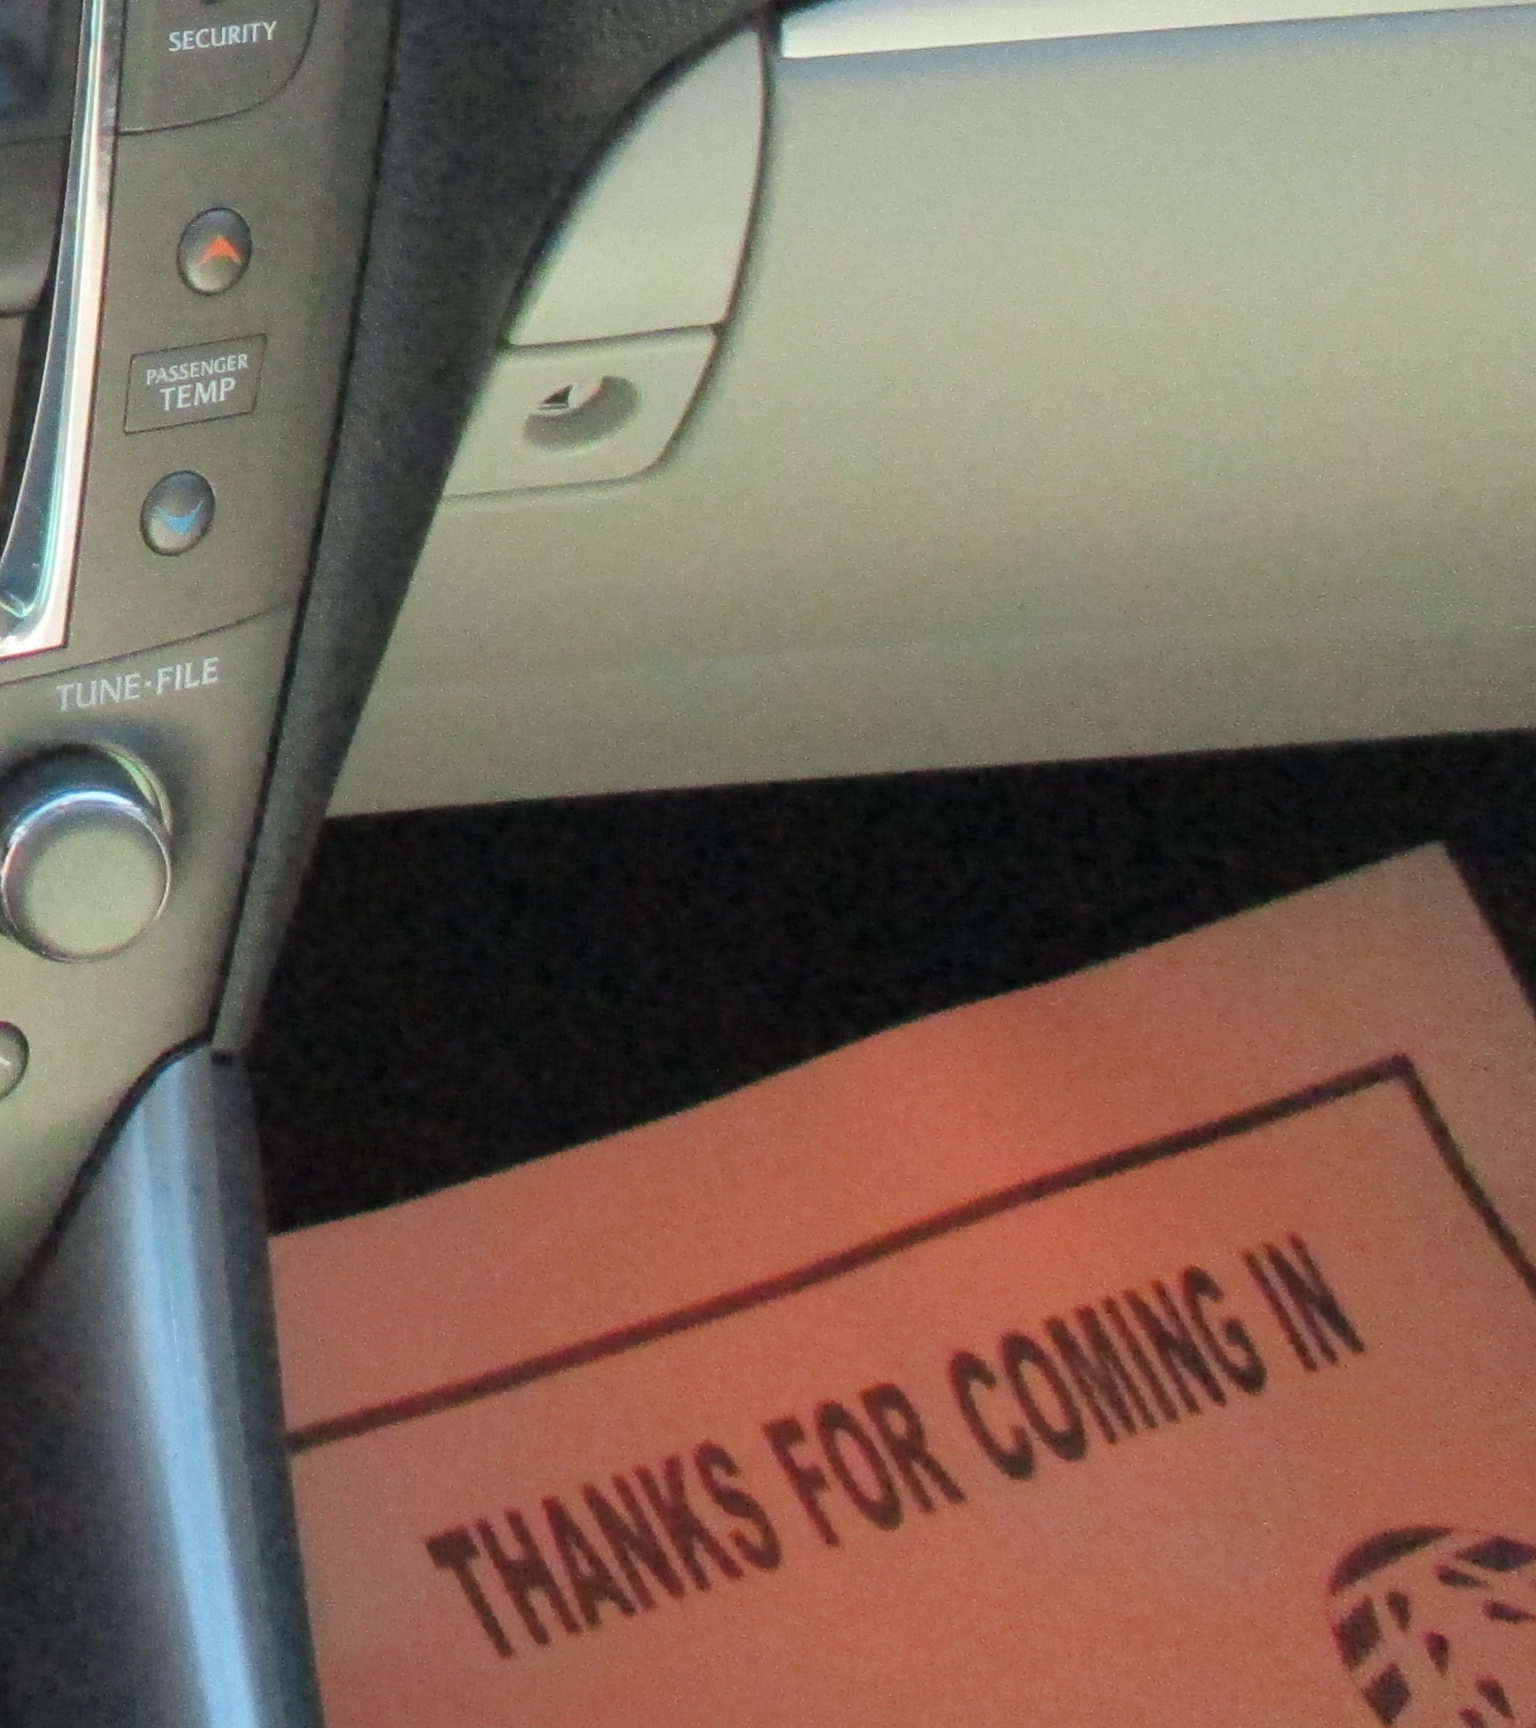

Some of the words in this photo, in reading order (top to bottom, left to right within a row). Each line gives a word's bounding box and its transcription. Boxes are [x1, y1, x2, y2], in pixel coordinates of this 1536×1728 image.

[168, 19, 278, 53] SECURITY
[144, 351, 250, 386] PASSENGER
[159, 377, 236, 413] TEMP
[424, 1437, 786, 1662] THANKS
[762, 1380, 966, 1552] FOR
[946, 1263, 1270, 1484] COMING
[1245, 1233, 1367, 1373] IN
